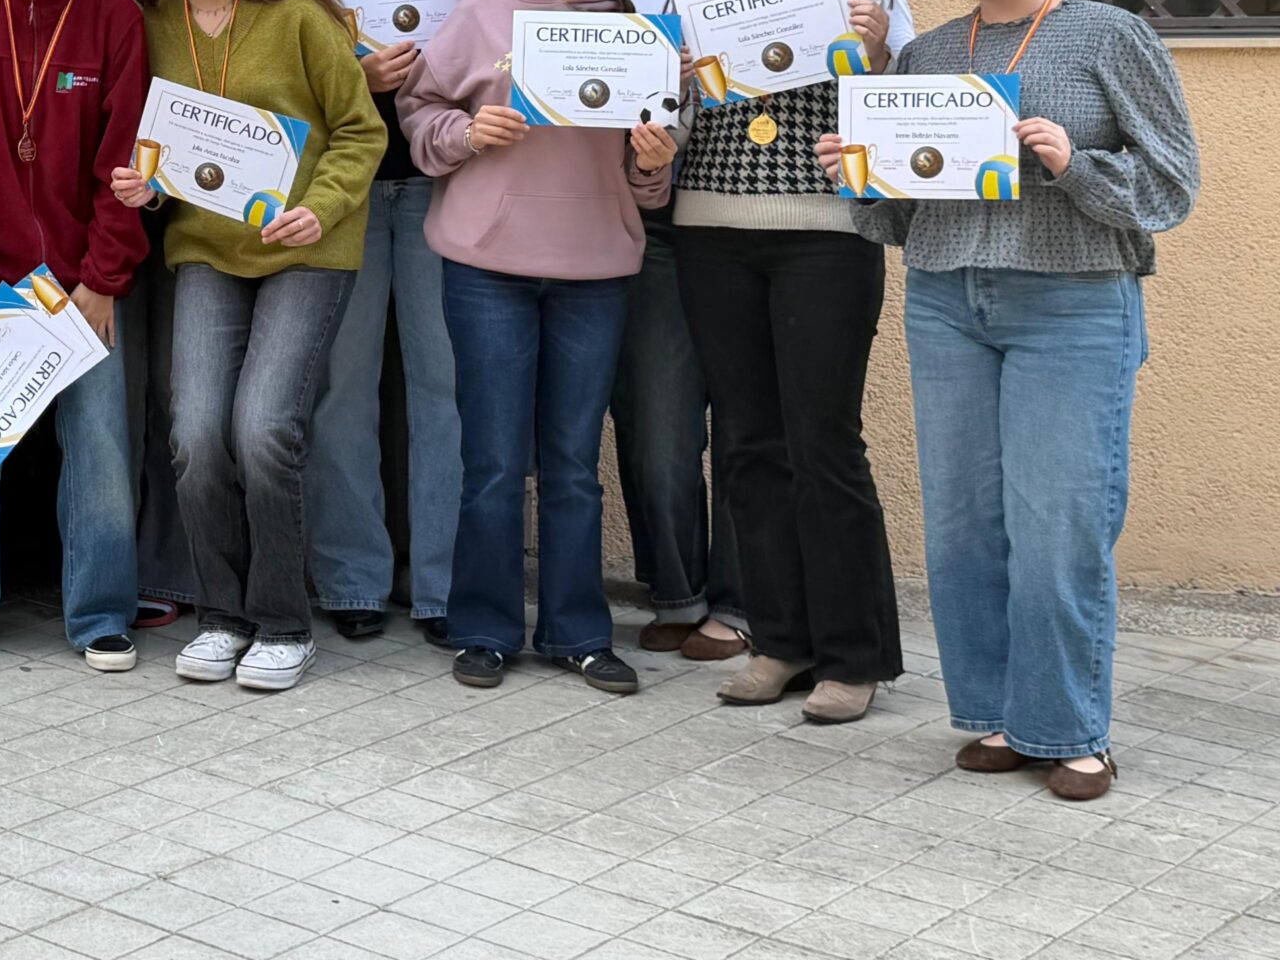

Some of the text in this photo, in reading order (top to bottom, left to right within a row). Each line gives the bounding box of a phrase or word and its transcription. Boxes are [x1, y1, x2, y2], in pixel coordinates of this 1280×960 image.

[536, 27, 657, 45] CERTIFICADO
[863, 91, 993, 108] CERTIFICADO
[170, 100, 282, 145] CERTIFICADO
